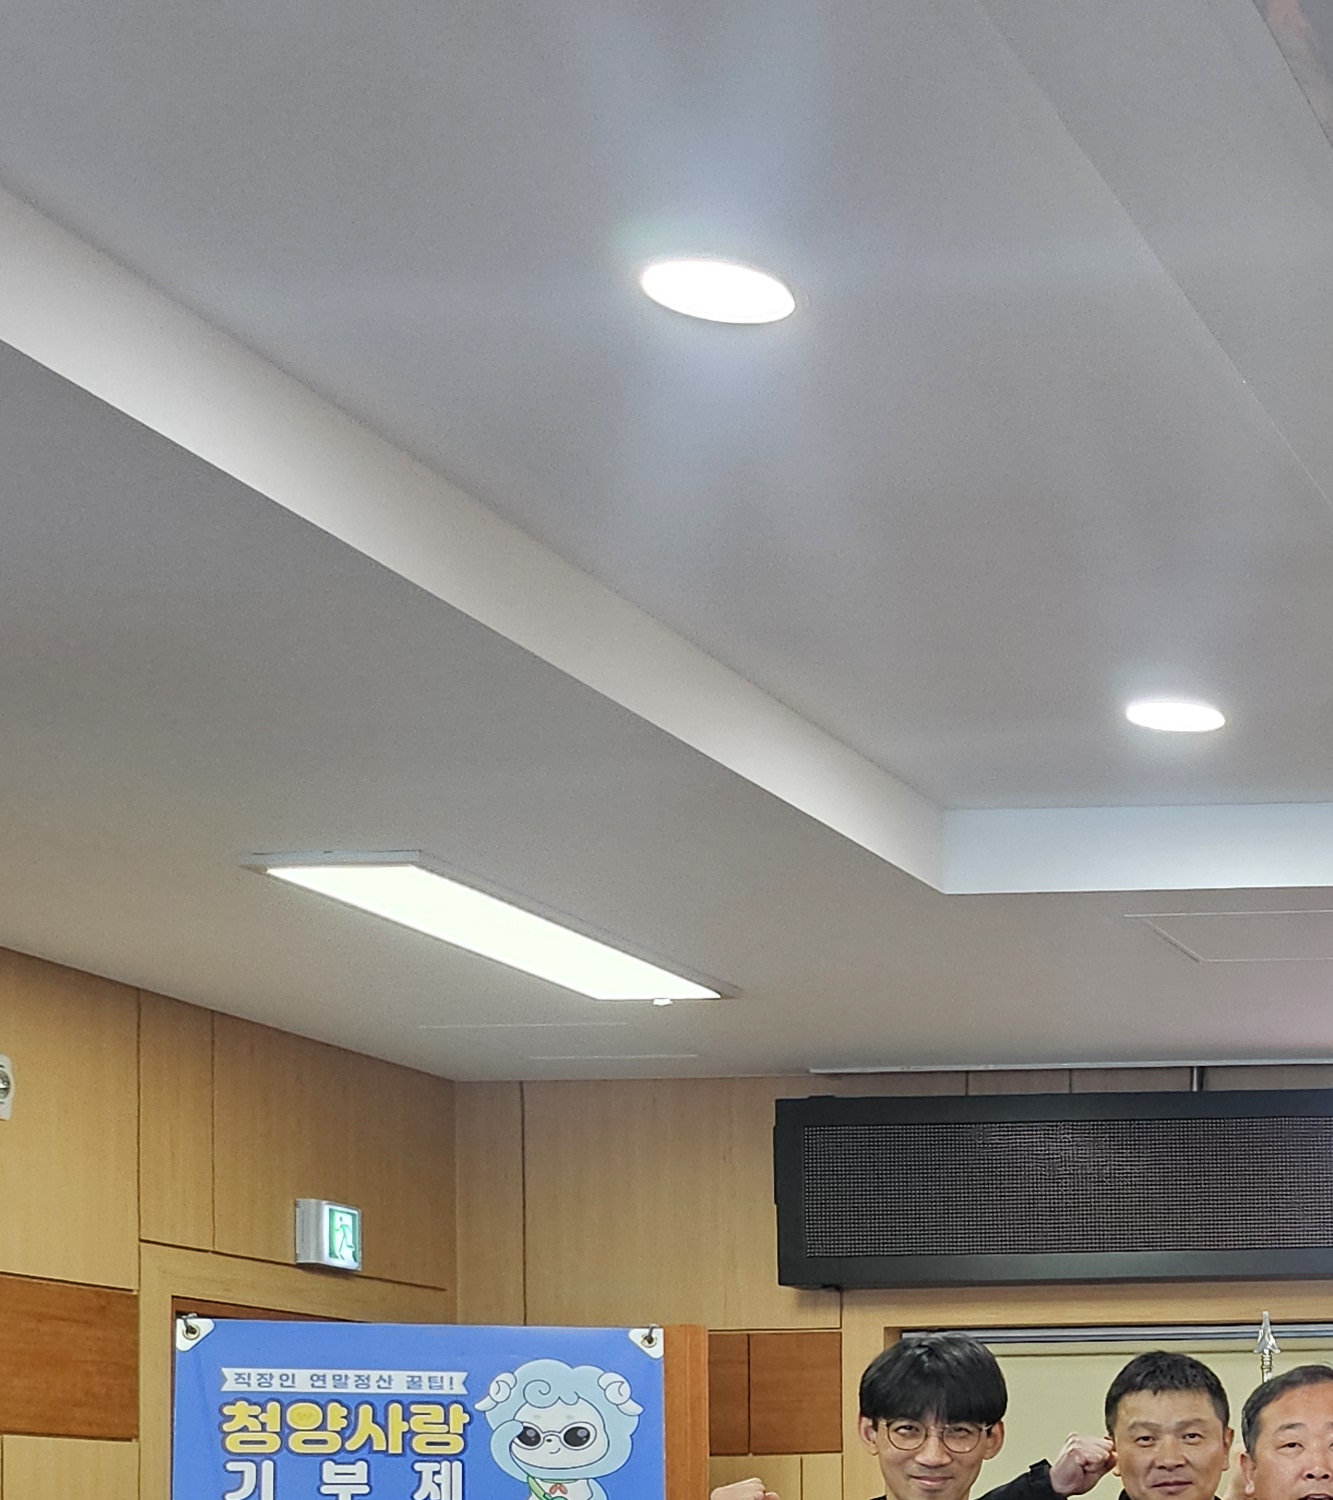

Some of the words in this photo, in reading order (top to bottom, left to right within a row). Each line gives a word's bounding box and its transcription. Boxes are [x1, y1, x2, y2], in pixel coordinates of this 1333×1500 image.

[233, 1371, 297, 1389] 직장인
[309, 1372, 394, 1391] 연말정산
[405, 1374, 455, 1392] 꿀팁!
[221, 1399, 472, 1455] 청양사랑
